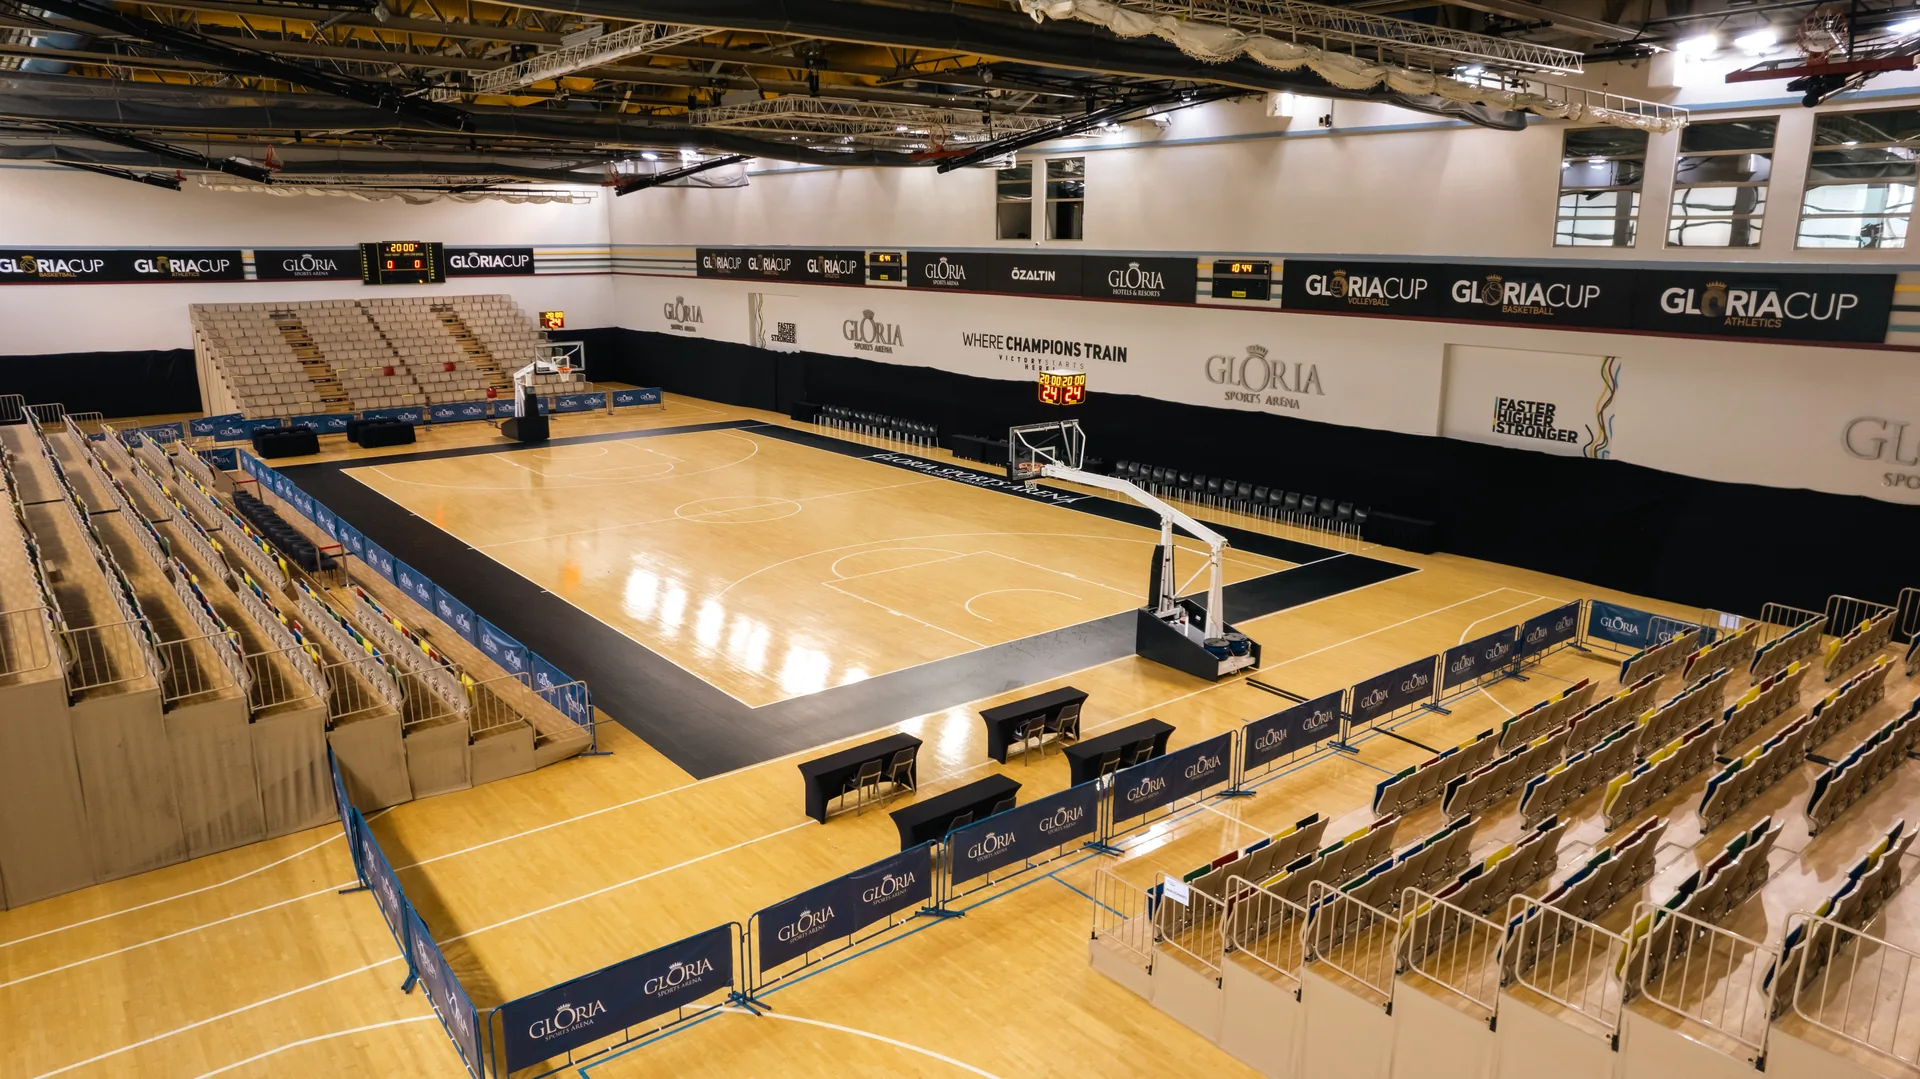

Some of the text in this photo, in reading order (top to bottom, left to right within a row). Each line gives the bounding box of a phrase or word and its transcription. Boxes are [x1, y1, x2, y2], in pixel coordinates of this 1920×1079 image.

[282, 257, 338, 271] GLORIA
[925, 260, 966, 280] GLORIA
[1011, 267, 1056, 282] ÖZALTIN
[1108, 268, 1165, 290] GLORIA
[1112, 288, 1132, 296] HOTELS
[1137, 290, 1161, 298] RESORTS
[1348, 297, 1390, 307] VOLLEYBALL
[663, 303, 705, 324] GLORIA
[1502, 305, 1554, 316] BASKETBALL
[549, 318, 562, 327] 24
[843, 317, 904, 347] GLORIA
[1724, 315, 1783, 329] ATHLETICS
[962, 331, 1128, 363] WHERE CHAMPIONS TRAIN
[1204, 353, 1326, 396] GLORIA
[1042, 385, 1058, 401] 24
[1065, 386, 1082, 402] 24
[1224, 391, 1301, 410] SPORTS ARENA
[397, 413, 418, 421] GLORIA
[1498, 397, 1557, 417] FASTER
[1496, 408, 1555, 428] HIGHER
[219, 427, 244, 436] GLORIA
[1495, 421, 1579, 444] STRONGER
[873, 453, 939, 472] GLORIA
[934, 467, 1011, 487] SPORTS
[1600, 617, 1639, 635] GLORIA
[1451, 655, 1475, 673] GLORIA
[1401, 674, 1429, 693] GLORIA
[1302, 710, 1334, 732] GLORIA
[1255, 728, 1287, 750] GLORIA
[1184, 755, 1221, 779] GLORIA
[1127, 776, 1166, 801] GLORIA
[1039, 806, 1084, 833] GLORIA
[967, 831, 1017, 860] GLORIA
[976, 847, 1008, 864] SPORTS ARENA
[862, 871, 916, 904] GLORIA
[872, 888, 908, 906] SPORTS ARENA
[777, 905, 836, 943] GLORIA
[789, 923, 826, 945] SPORTS ARENA
[643, 957, 714, 997] GLORIA
[657, 976, 703, 999] SPORTS ARENA
[528, 999, 608, 1040] GLORIA
[544, 1018, 594, 1042] SPORTS ARENA
